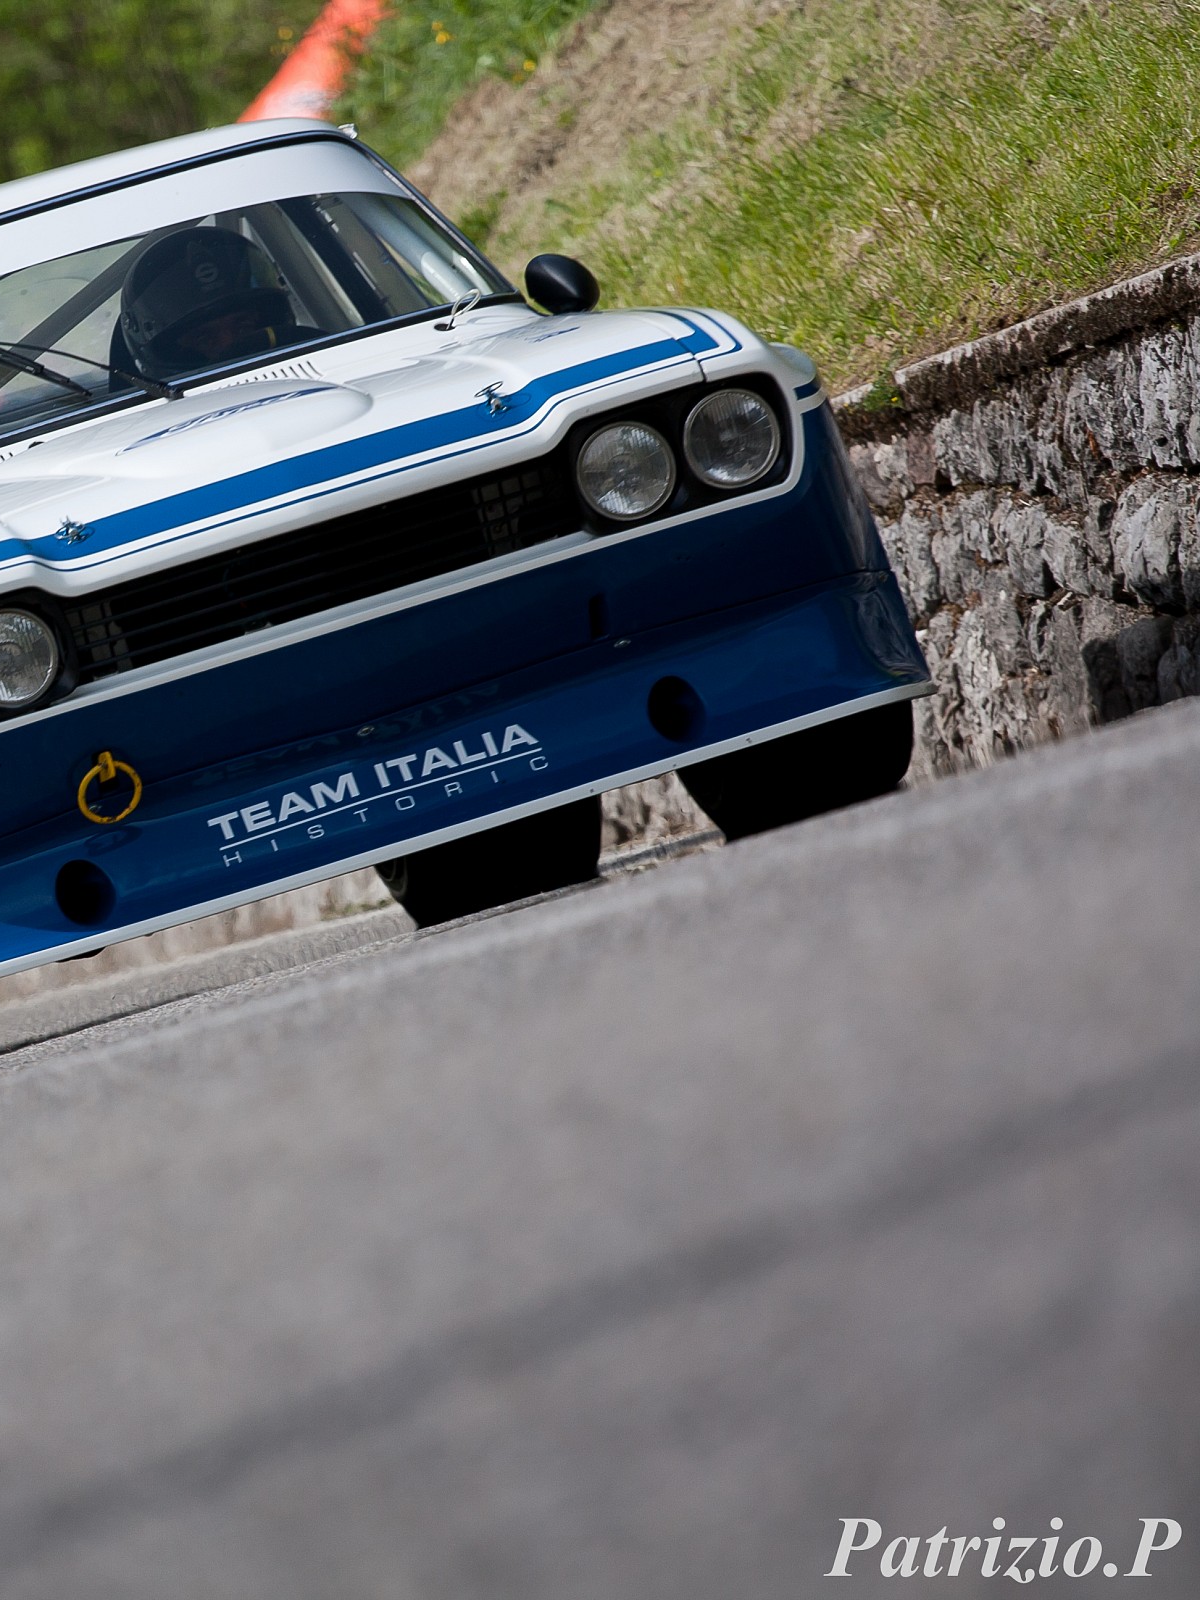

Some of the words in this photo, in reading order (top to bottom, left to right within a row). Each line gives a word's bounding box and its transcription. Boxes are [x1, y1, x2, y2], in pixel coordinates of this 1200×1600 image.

[207, 772, 360, 840] TEAM
[373, 724, 539, 788] ITALIA
[223, 755, 549, 867] HISTORIC
